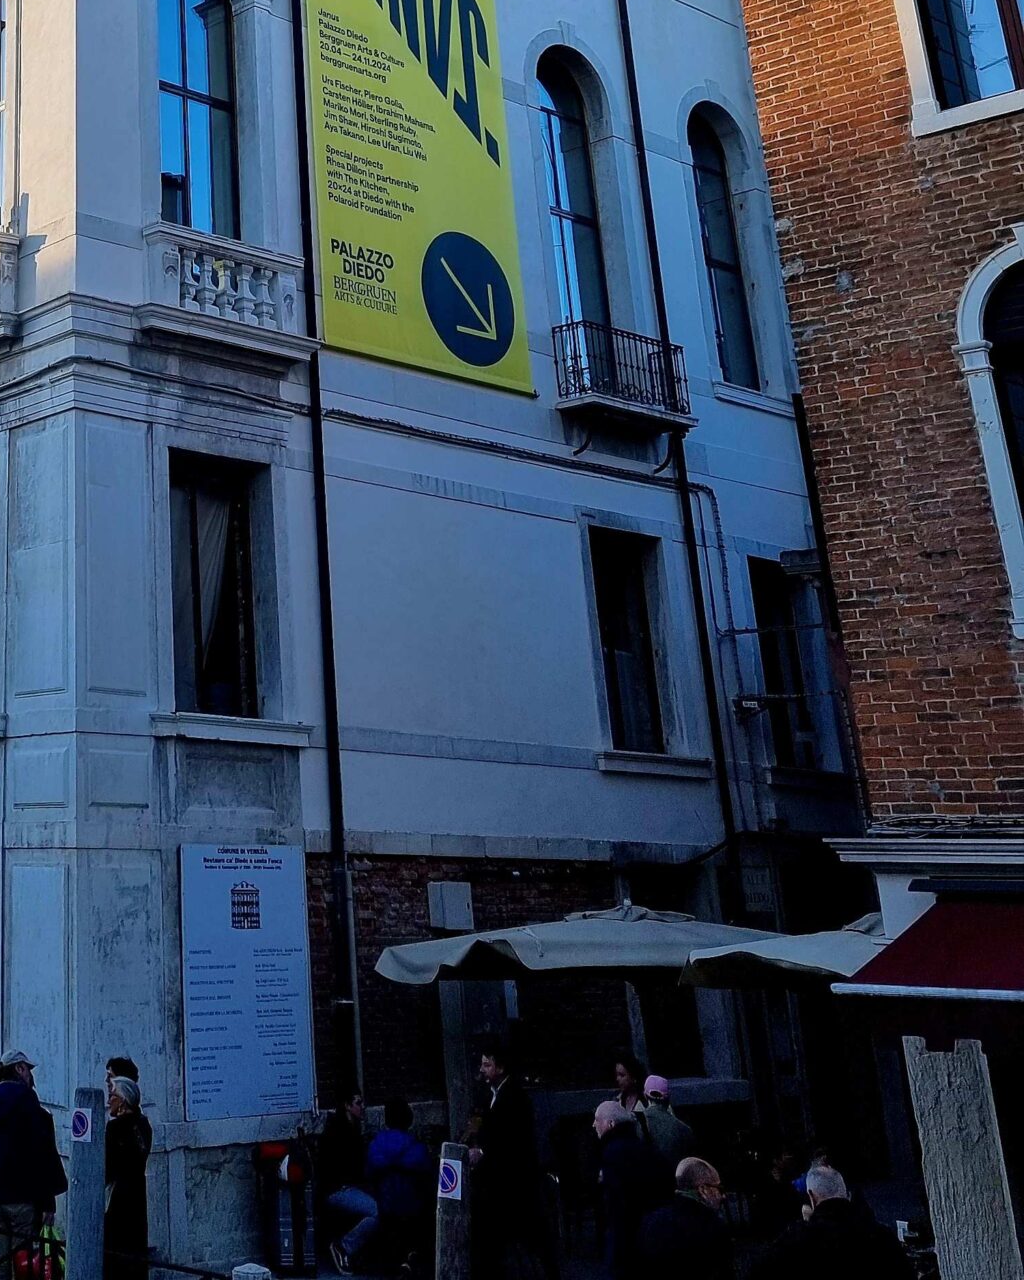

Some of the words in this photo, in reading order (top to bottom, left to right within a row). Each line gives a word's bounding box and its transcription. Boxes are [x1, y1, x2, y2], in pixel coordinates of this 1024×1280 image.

[318, 8, 339, 22] Janus
[319, 19, 345, 36] Palazzo
[347, 30, 368, 43] Diedo
[320, 30, 356, 49] Berggruen
[357, 44, 372, 56] Arts
[374, 49, 379, 57] &
[381, 52, 404, 68] Culture
[320, 41, 341, 55] 20.04
[352, 53, 391, 72] 24.11.2024
[320, 52, 386, 83] berggruenarts.org
[322, 74, 333, 86] Urs
[335, 80, 363, 97] Fischer,
[364, 90, 383, 103] Piero
[385, 97, 404, 110] Golia,
[323, 87, 350, 102] Carsten
[376, 105, 403, 120] Ibrahim
[405, 114, 435, 133] Mahama,
[323, 98, 348, 113] Mariko
[350, 108, 368, 121] Mori,
[370, 114, 398, 130] Sterling
[324, 110, 337, 121] Jim
[339, 115, 359, 129] Shaw,
[361, 122, 386, 137] Hiroshi
[388, 131, 423, 150] Sugimoto,
[324, 121, 338, 133] Aya
[339, 126, 366, 143] Takano,
[368, 136, 380, 146] Lee
[382, 140, 402, 154] Ufan,
[403, 146, 413, 157] Liu
[414, 150, 427, 161] Wei
[326, 144, 352, 160] Special
[354, 156, 383, 170] projects
[326, 156, 345, 169] Rhea
[346, 162, 367, 176] Dillon
[368, 169, 375, 178] in
[377, 174, 419, 192] partnership
[327, 169, 343, 180] with
[344, 174, 358, 185] The
[360, 178, 390, 196] Kitchen,
[328, 192, 358, 209] Polaroid
[360, 202, 402, 221] Foundation
[353, 189, 361, 197] at
[362, 191, 383, 205] Diedo
[385, 198, 400, 210] with
[402, 203, 414, 213] the
[331, 238, 394, 269] PALAZZO
[343, 258, 385, 283] DIEDO
[334, 276, 396, 304] BERGGRUEN
[335, 291, 354, 304] ARTS
[356, 296, 362, 306] &
[364, 298, 397, 315] CULTURE
